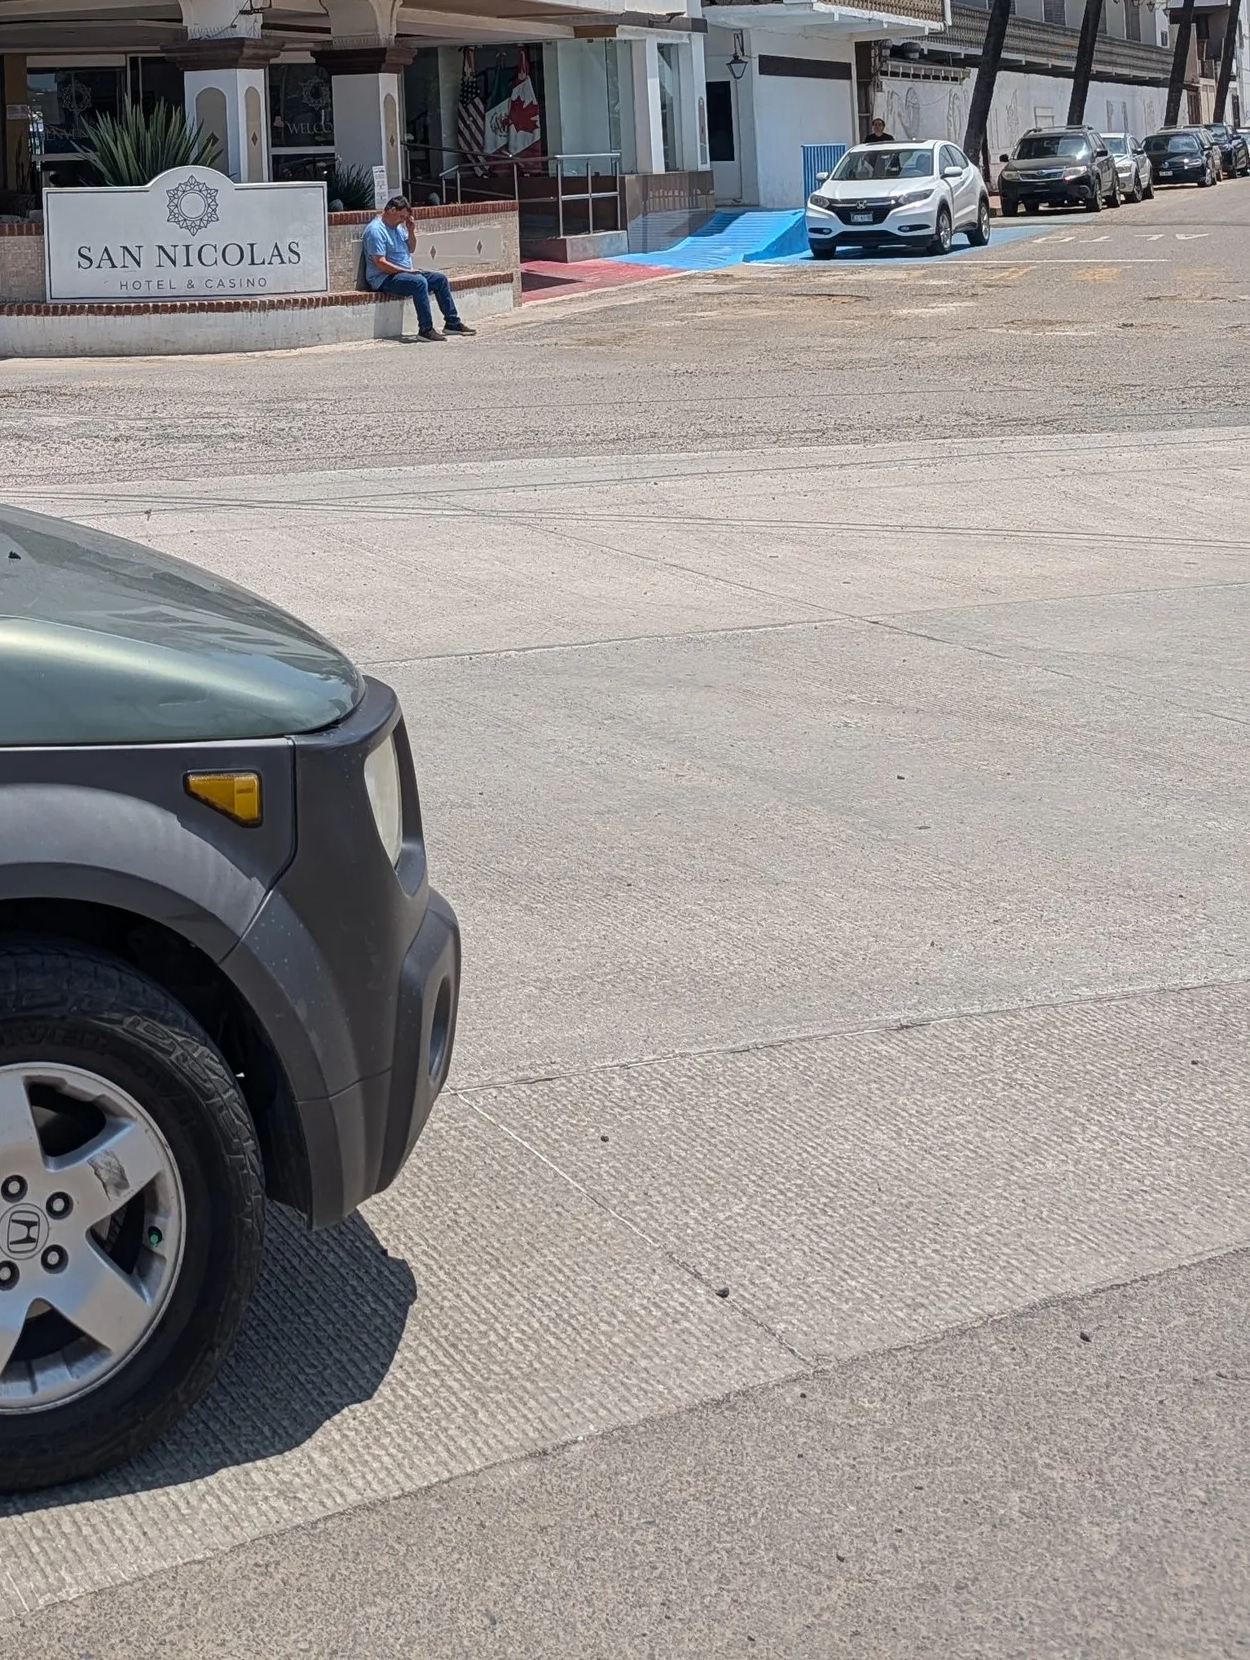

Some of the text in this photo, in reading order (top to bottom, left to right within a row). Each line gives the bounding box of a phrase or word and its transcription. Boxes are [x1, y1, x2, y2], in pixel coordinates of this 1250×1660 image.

[285, 121, 333, 135] WELCO
[77, 240, 301, 270] SAN NICOLAS
[119, 276, 268, 291] HOTEL & CASINO
